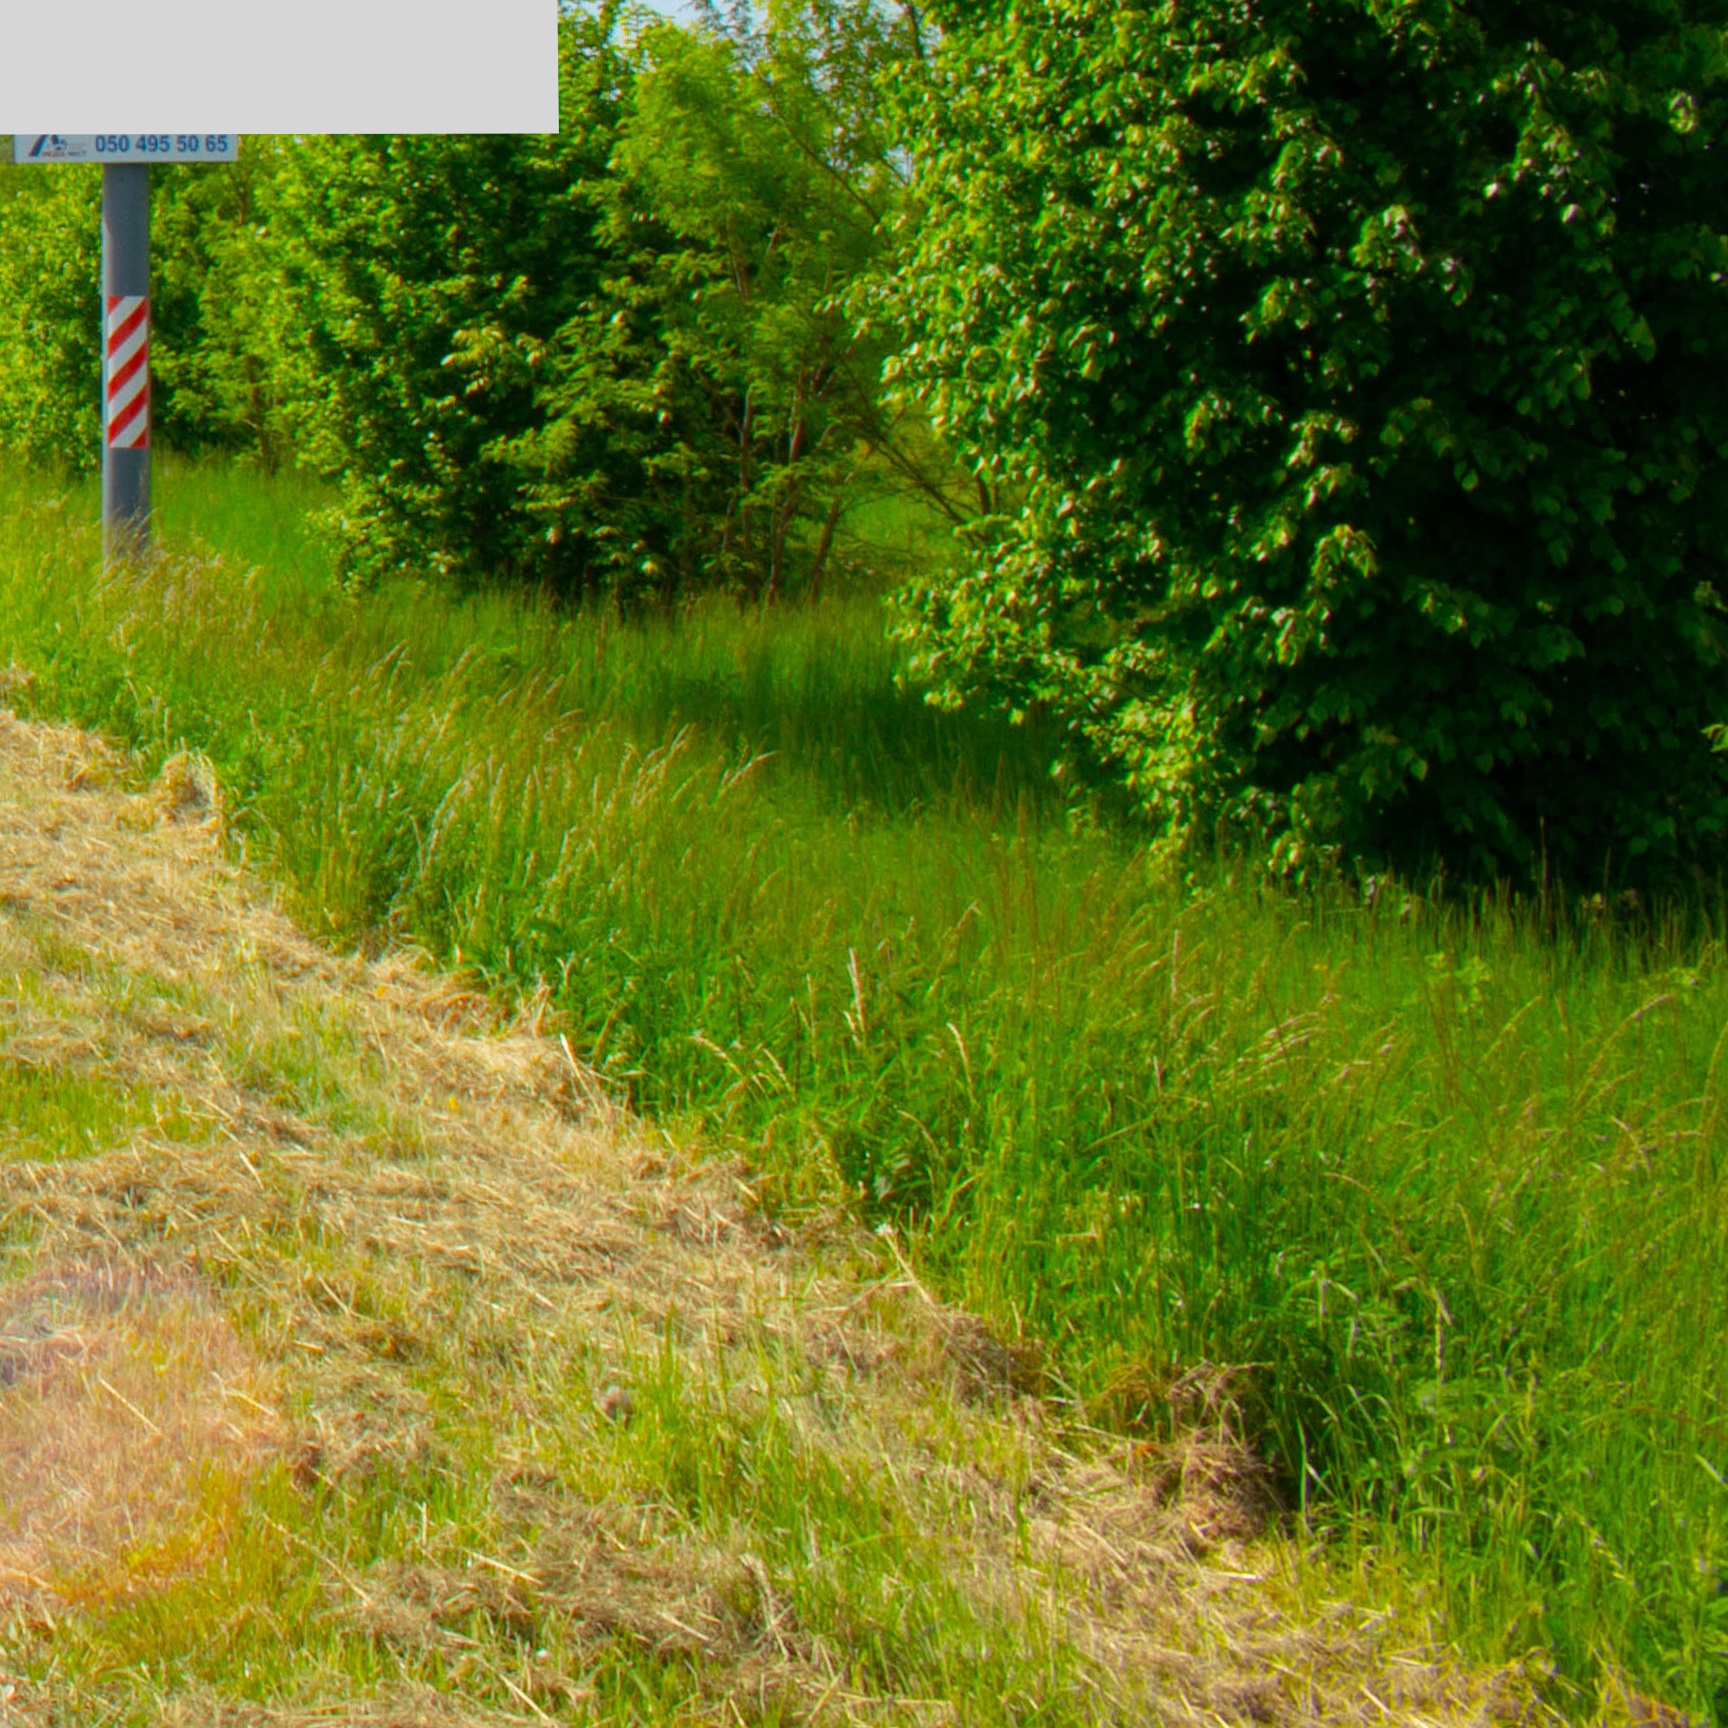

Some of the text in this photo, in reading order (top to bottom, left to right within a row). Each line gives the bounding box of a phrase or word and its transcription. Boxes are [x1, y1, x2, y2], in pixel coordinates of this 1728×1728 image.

[95, 134, 228, 152] 050 495 50 65
